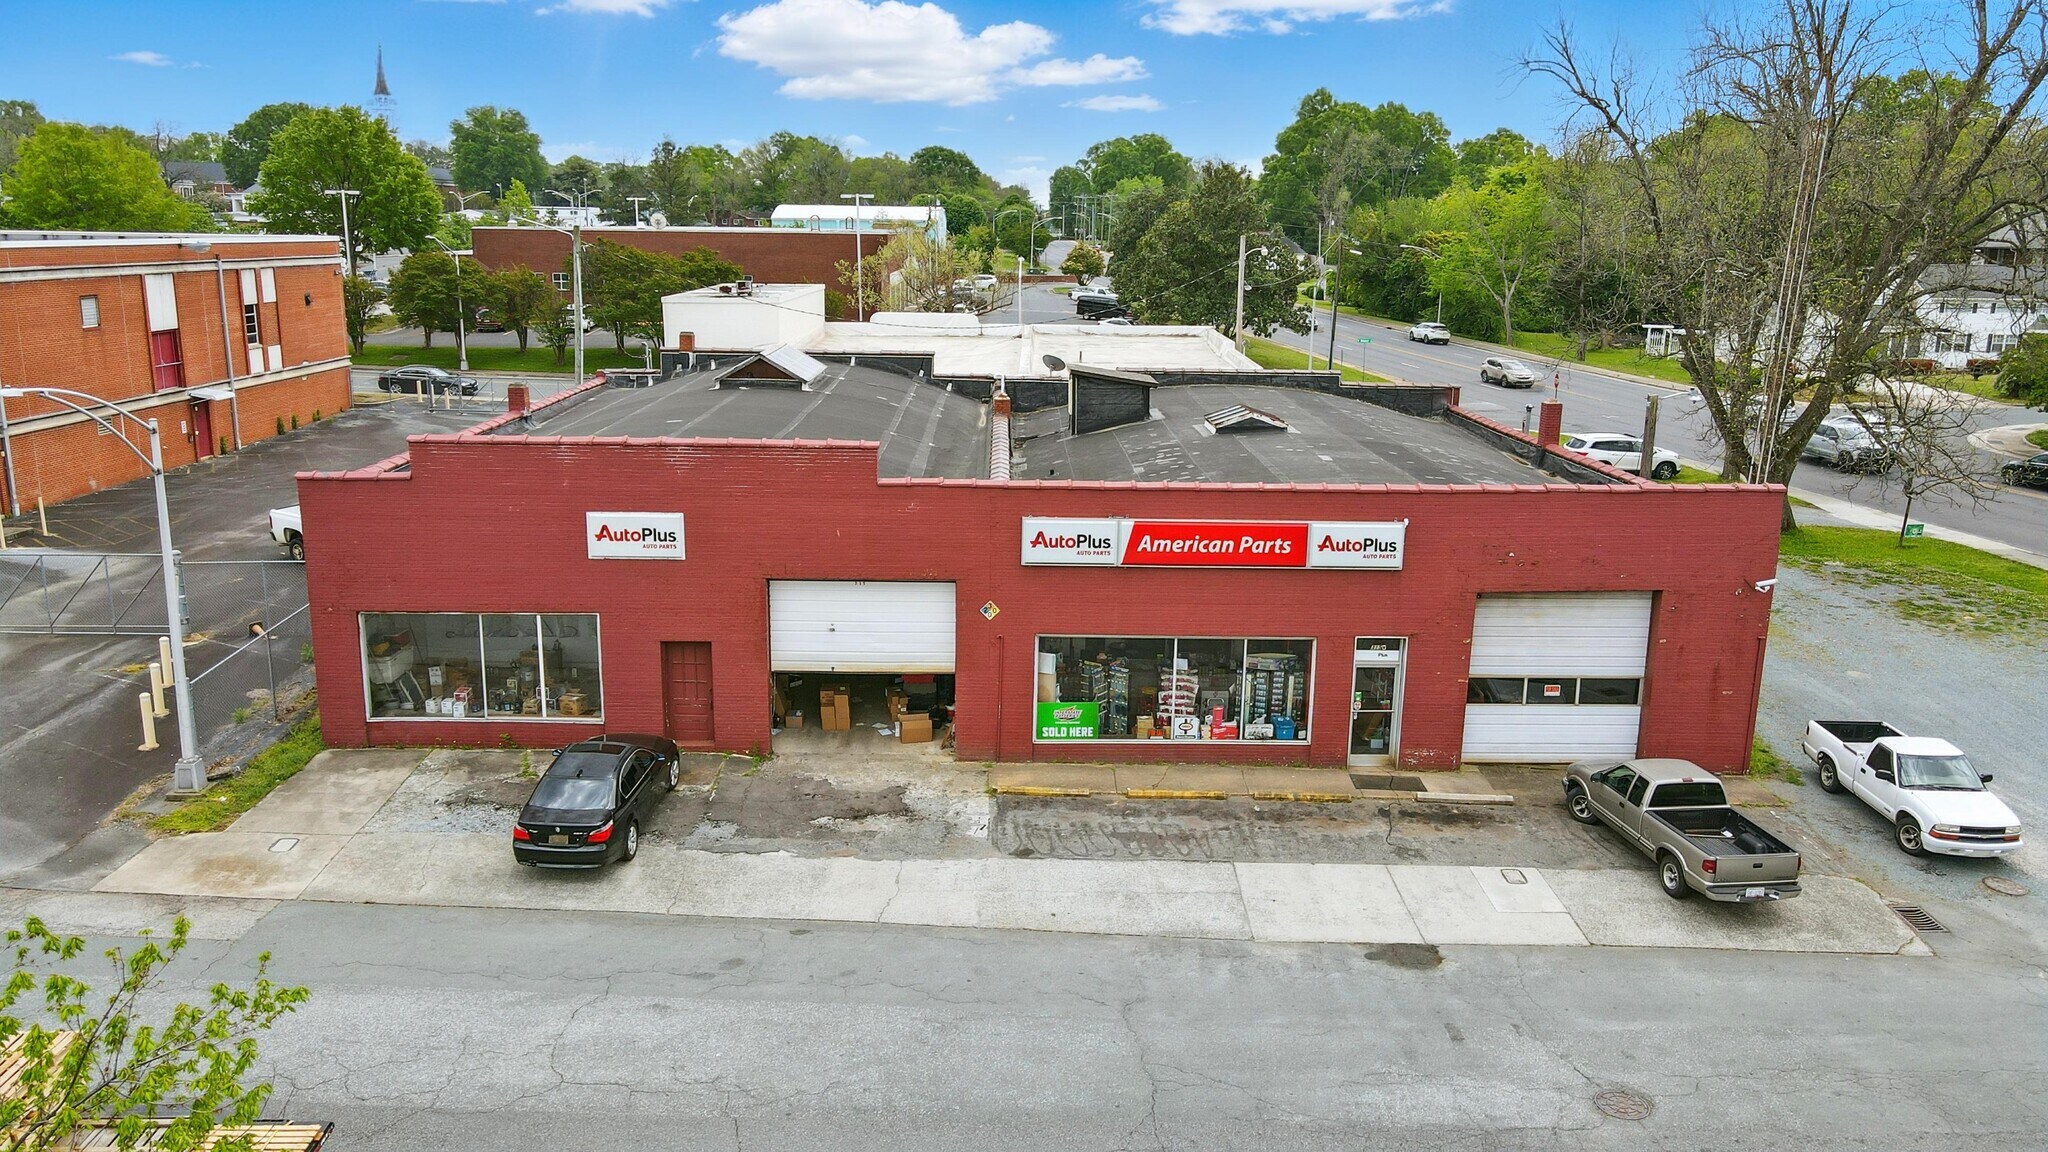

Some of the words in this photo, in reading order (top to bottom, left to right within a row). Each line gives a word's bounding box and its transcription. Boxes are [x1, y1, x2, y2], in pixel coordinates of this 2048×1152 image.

[595, 525, 677, 542] AutoPlus
[1030, 531, 1111, 549] AutoPlus
[1137, 535, 1235, 553] American
[1239, 536, 1292, 554] Parts
[1318, 535, 1397, 552] AutoPlus
[1042, 727, 1067, 737] SOLD
[1069, 727, 1094, 737] HERE
